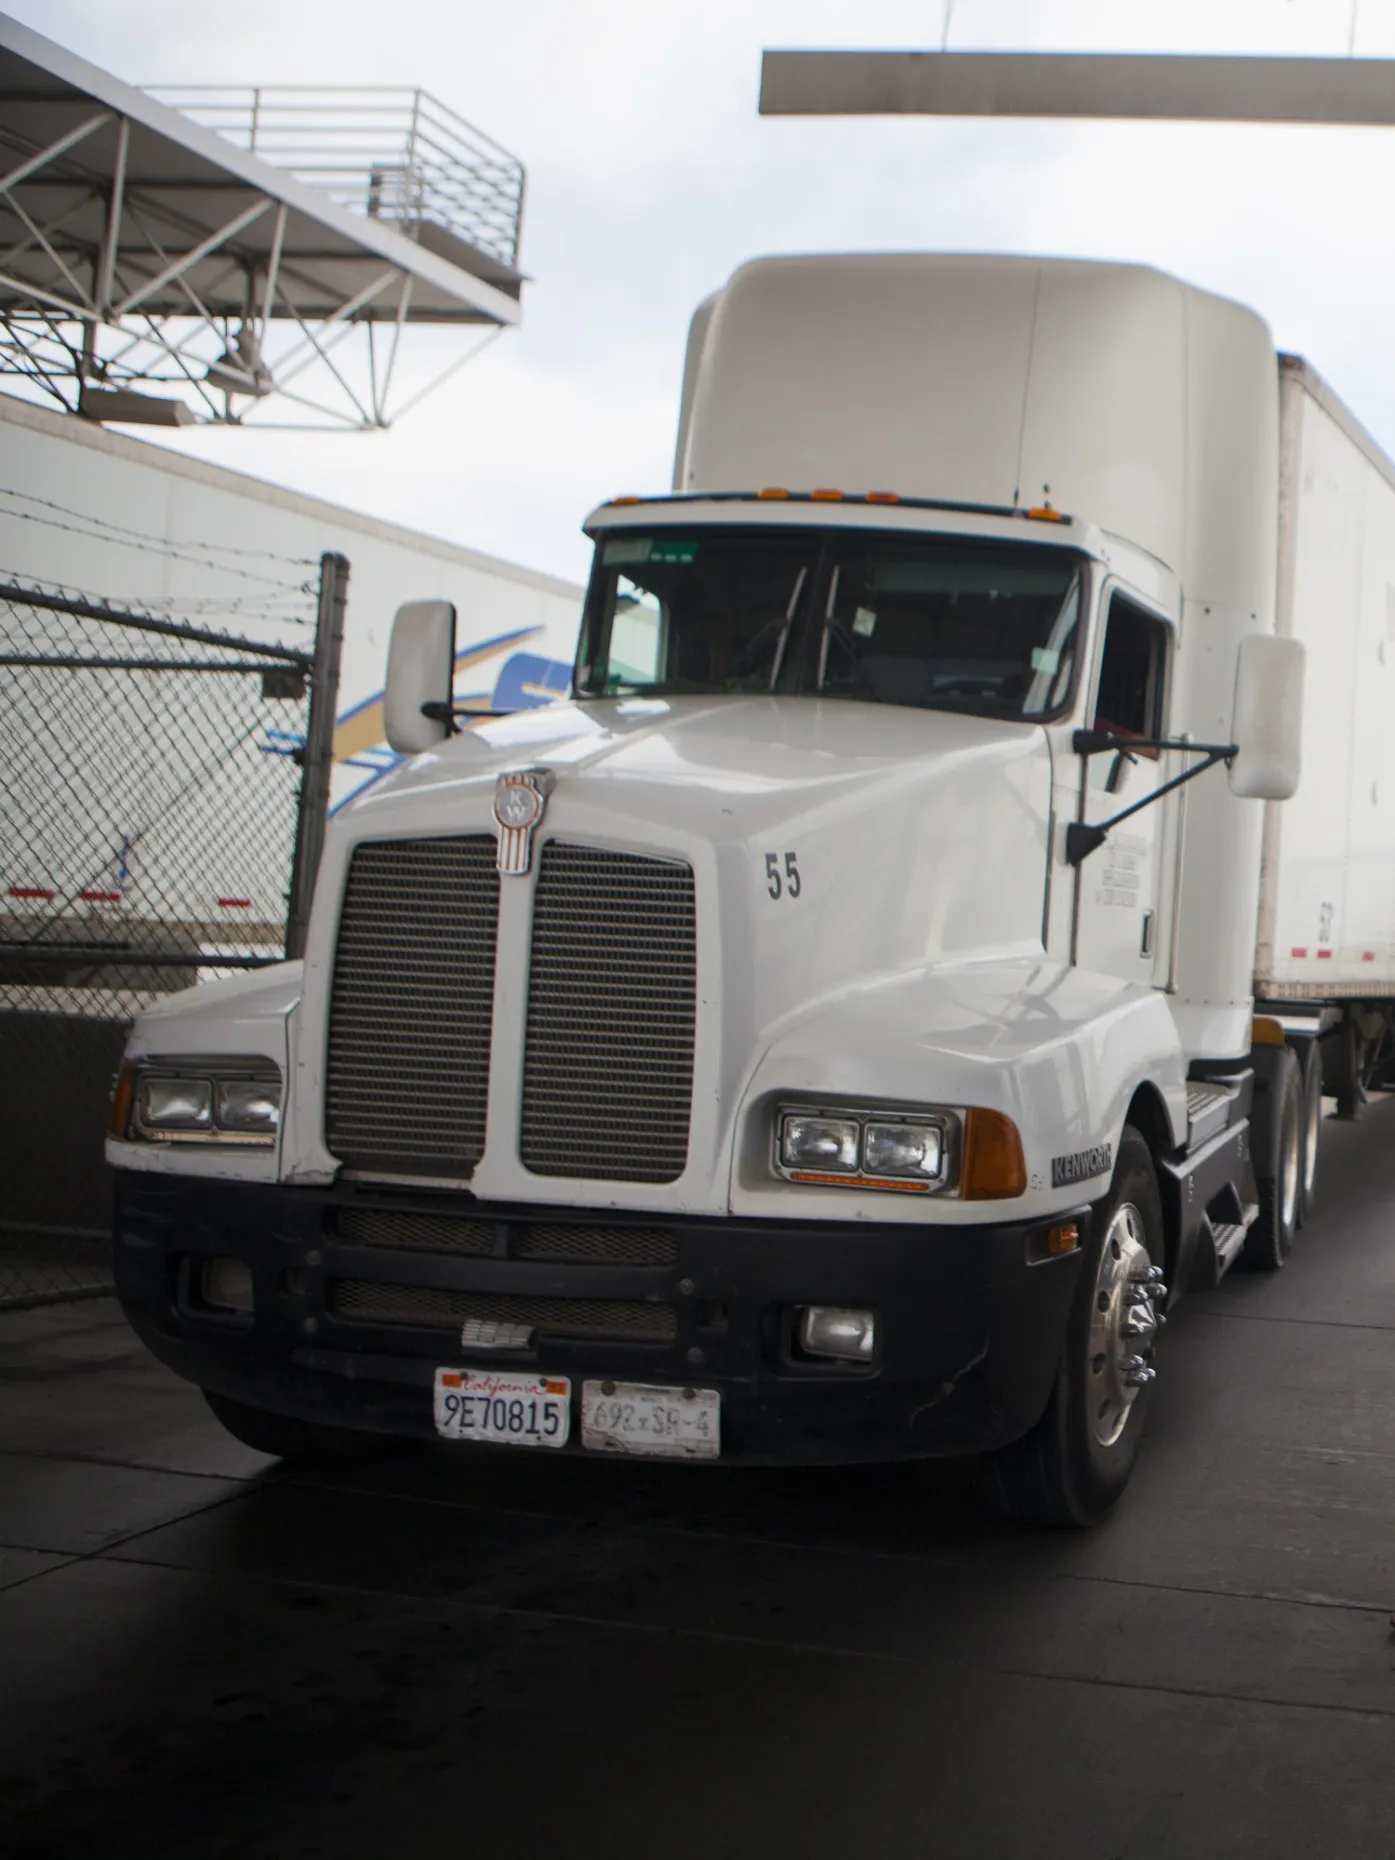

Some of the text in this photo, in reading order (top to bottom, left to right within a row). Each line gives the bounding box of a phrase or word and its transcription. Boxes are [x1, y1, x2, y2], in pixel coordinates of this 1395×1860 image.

[764, 851, 801, 900] 55
[463, 1374, 545, 1397] California
[444, 1394, 559, 1436] 9E70815
